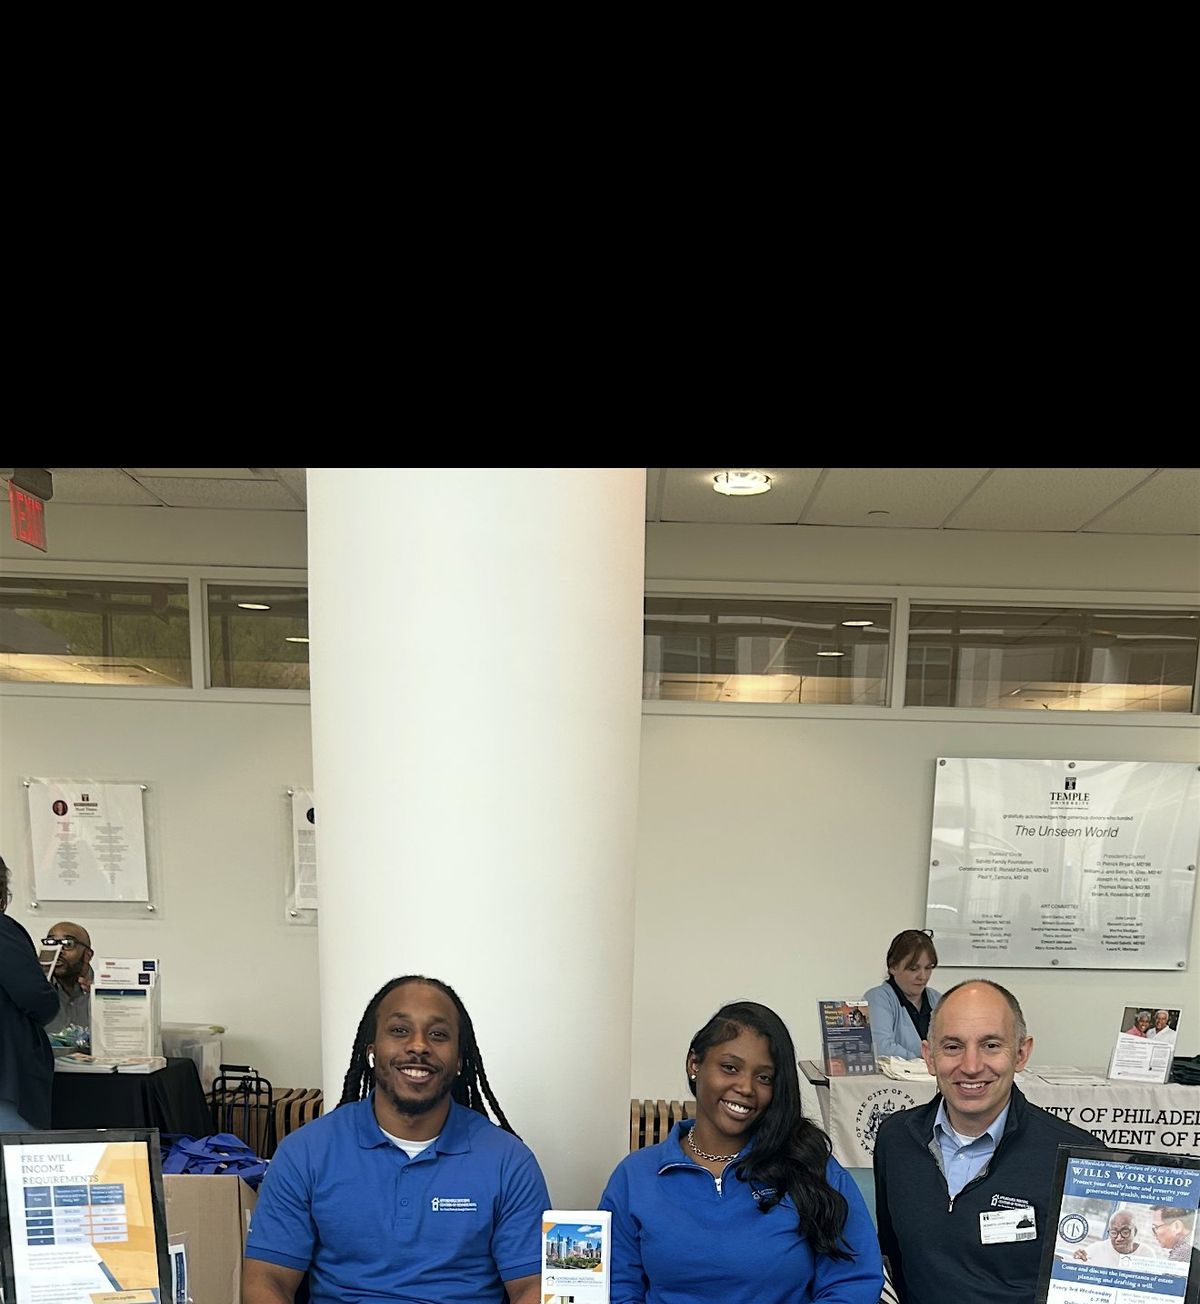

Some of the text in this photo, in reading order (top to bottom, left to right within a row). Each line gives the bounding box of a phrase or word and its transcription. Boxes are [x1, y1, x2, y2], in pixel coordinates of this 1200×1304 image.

[1049, 792, 1090, 801] TEMPLE
[1015, 825, 1119, 838] The Unseen World
[1080, 1107, 1108, 1123] OF
[1160, 1131, 1188, 1147] OF
[21, 1153, 72, 1163] FREE WILL
[21, 1164, 65, 1174] INCOME
[23, 1174, 99, 1185] REQUIREMENTS
[1072, 1167, 1193, 1188] WILLS WORKSHOP
[1107, 1181, 1124, 1190] family
[1152, 1187, 1176, 1196] preserve
[1176, 1189, 1190, 1197] your
[1061, 1264, 1077, 1272] Come
[1089, 1267, 1108, 1275] discuss
[1118, 1270, 1150, 1281] importance
[1077, 1273, 1102, 1283] planning
[1113, 1277, 1136, 1288] drafting
[1079, 1286, 1112, 1297] Wednesday
